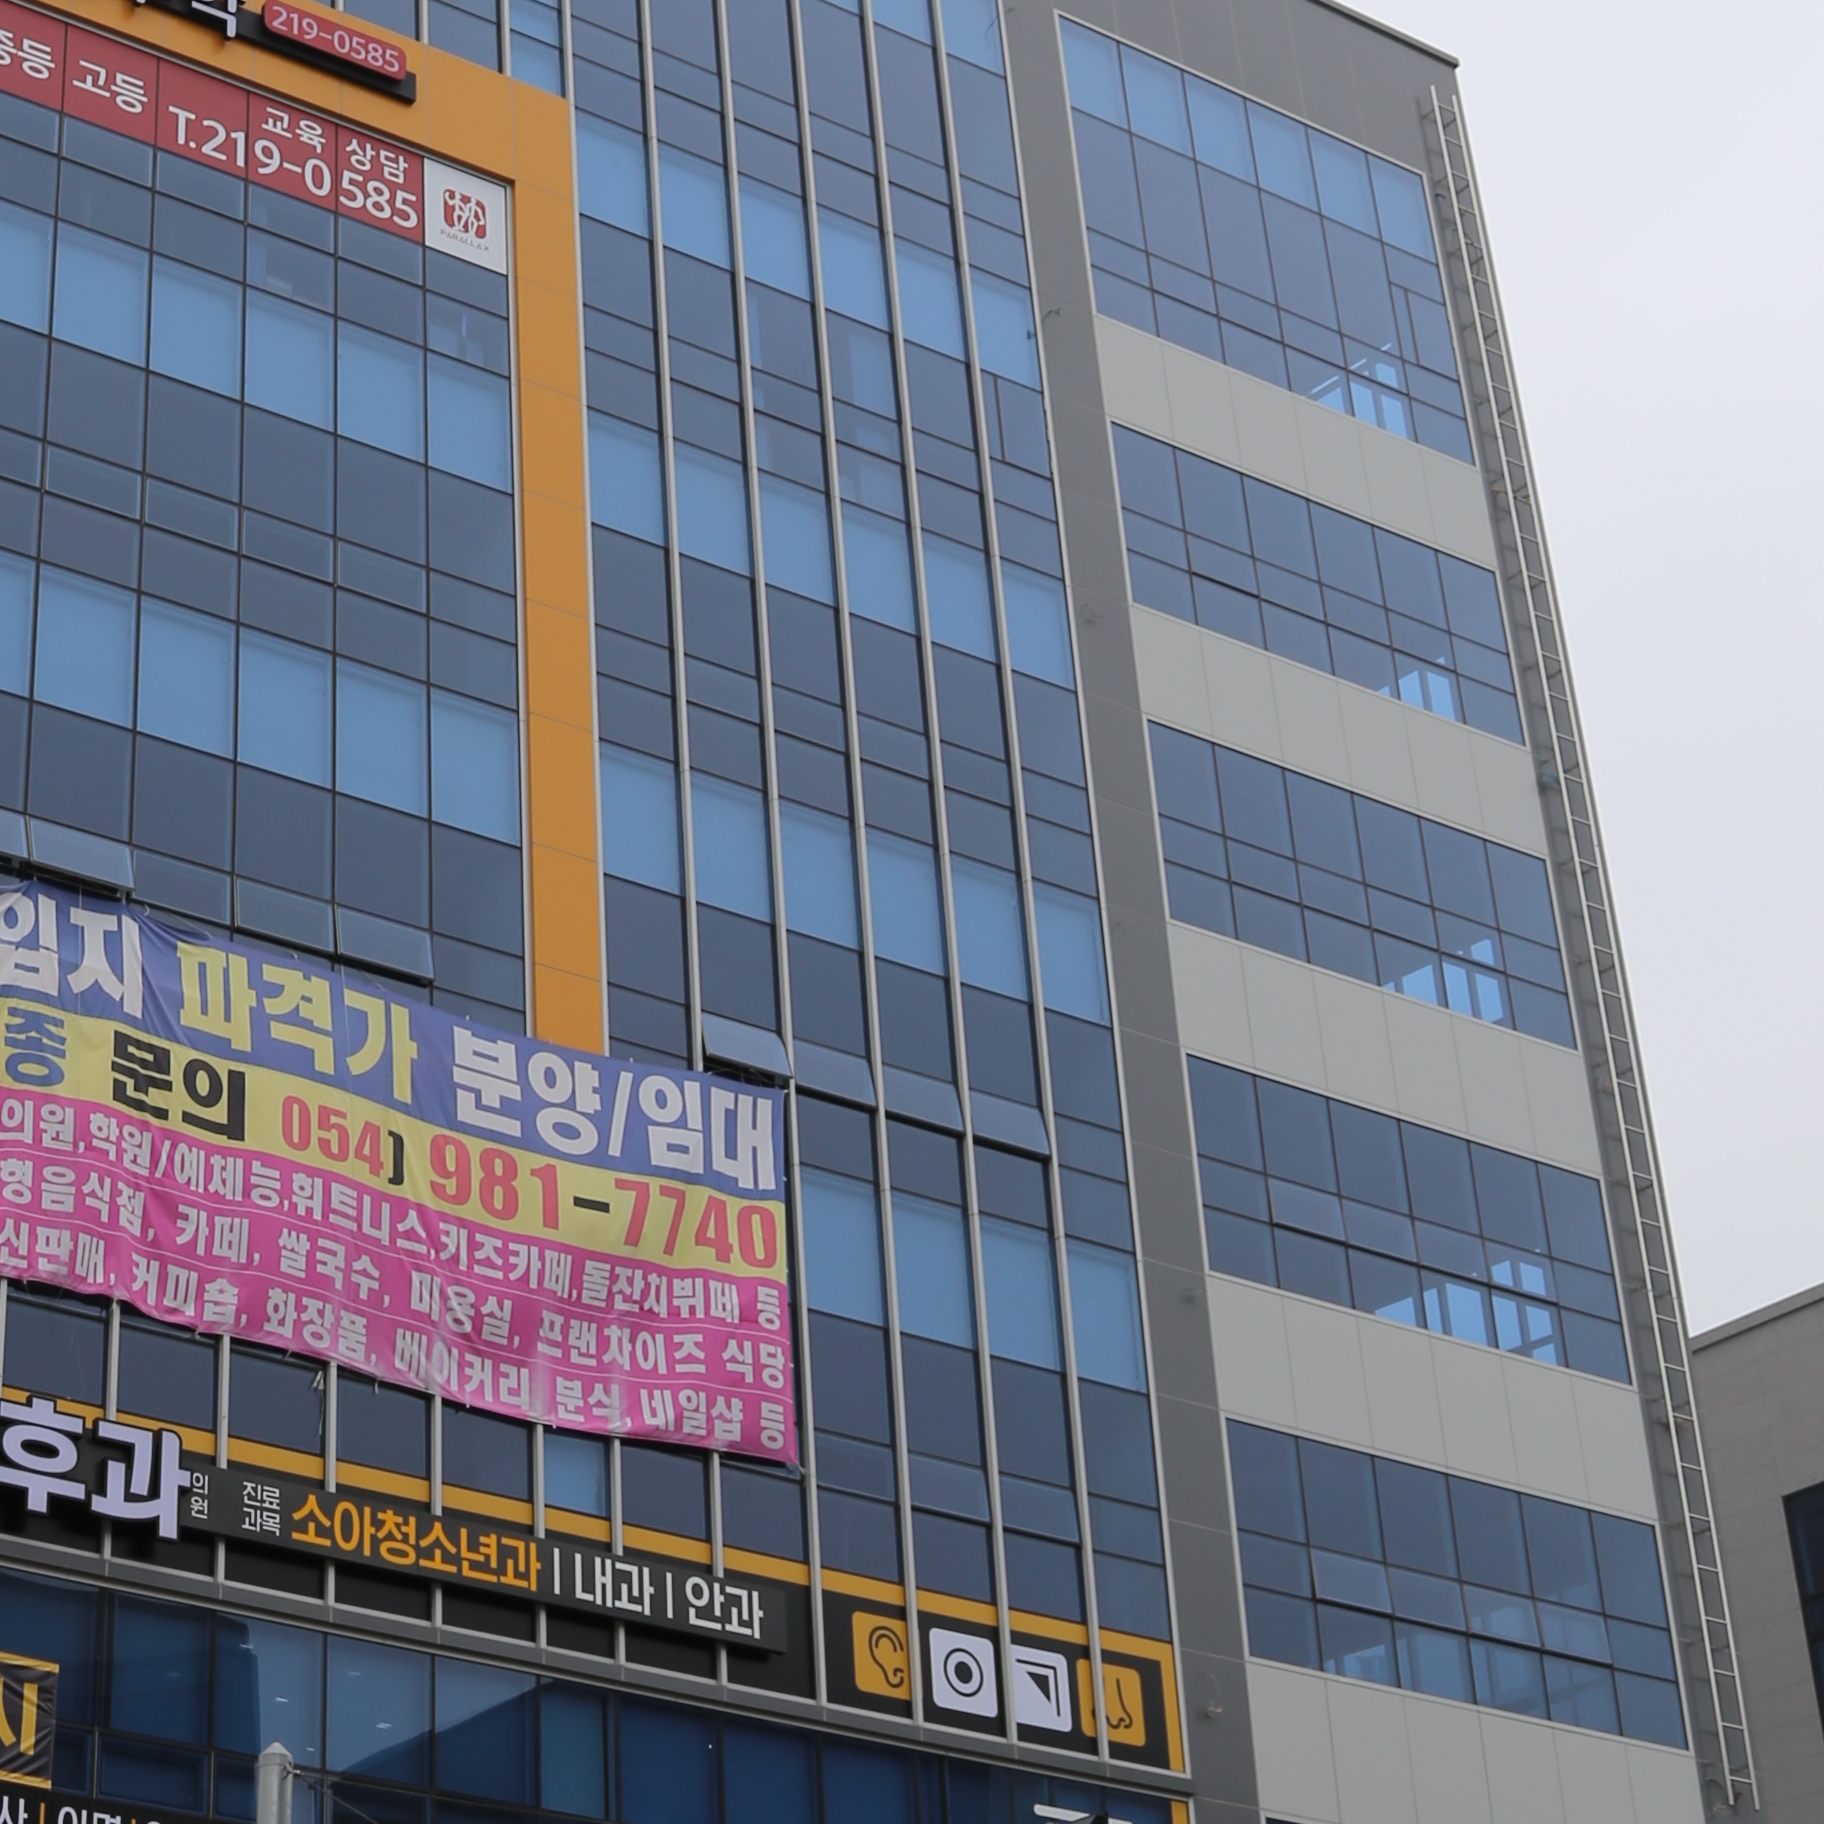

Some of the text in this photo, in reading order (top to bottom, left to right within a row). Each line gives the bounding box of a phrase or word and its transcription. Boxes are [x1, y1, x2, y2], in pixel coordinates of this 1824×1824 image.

[268, 2, 404, 75] 219-0585
[72, 57, 148, 116] 고등
[168, 104, 419, 230] T.219-0585
[260, 104, 410, 185] 교육 상담
[177, 943, 417, 1104] 파격가
[452, 1025, 776, 1191] 분양/임대
[111, 1030, 246, 1142] 문의
[429, 1133, 777, 1269] 981-7740
[756, 1288, 781, 1331] 등
[537, 1308, 706, 1374] 프랜차이즈
[722, 1339, 785, 1390] 식당
[640, 1388, 743, 1443] 네일샵
[760, 1402, 785, 1451] 등
[189, 1472, 210, 1521] 의원
[241, 1508, 282, 1537] 과목
[241, 1479, 764, 1640] 진료 소아청소년과 내과 안과
